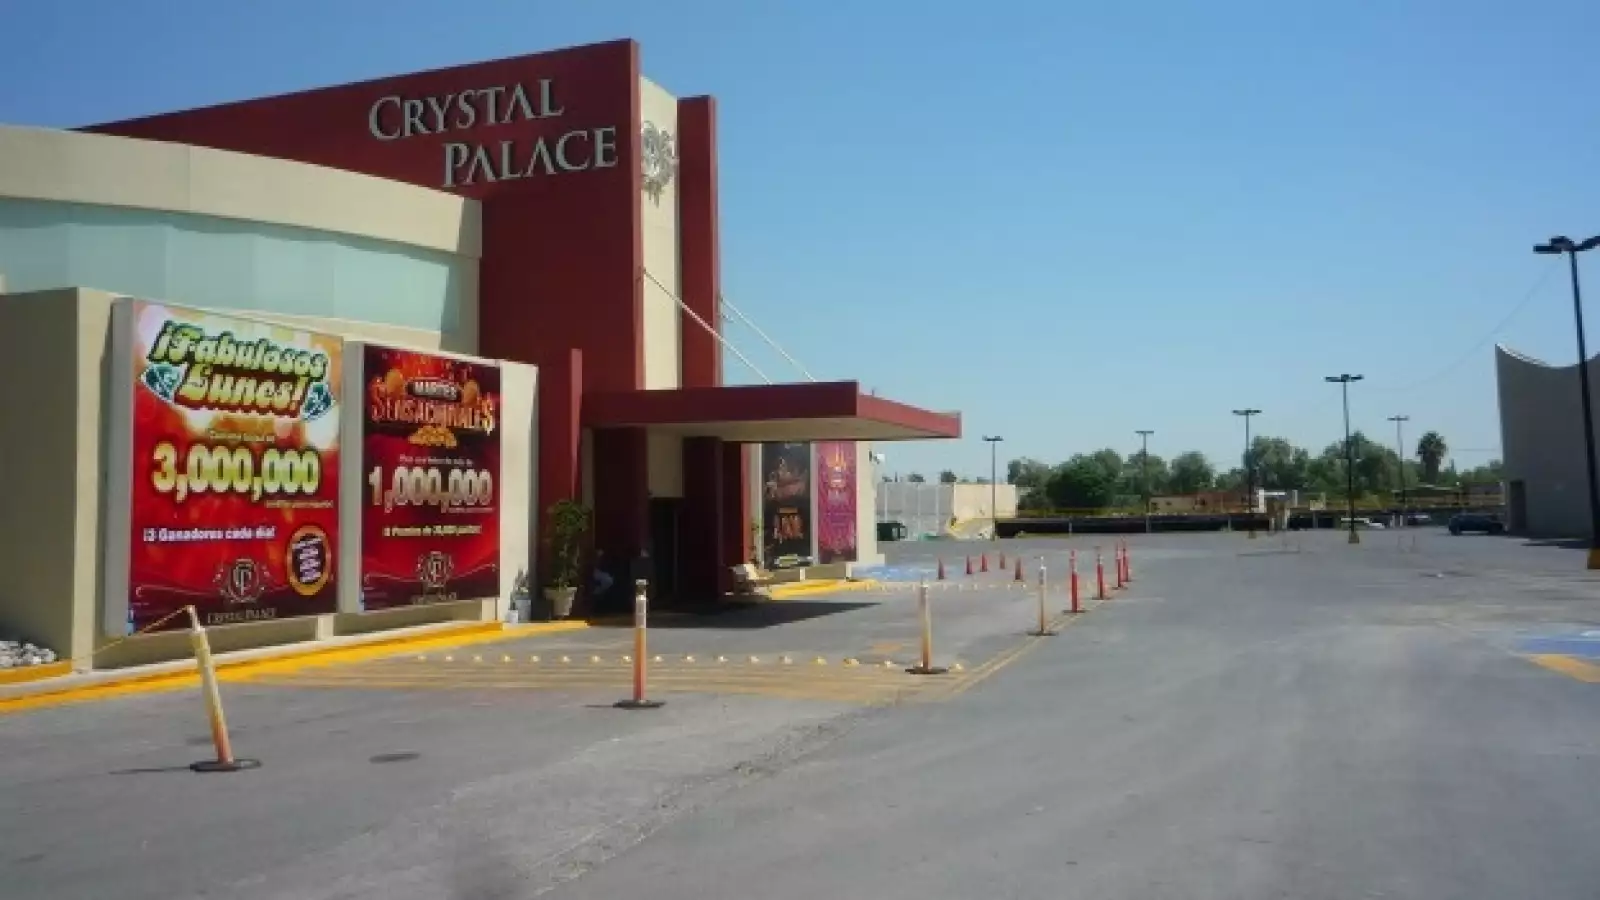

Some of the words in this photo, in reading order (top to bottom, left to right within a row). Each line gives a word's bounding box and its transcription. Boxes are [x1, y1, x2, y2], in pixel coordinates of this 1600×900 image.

[368, 78, 564, 141] CRYSTAL
[442, 126, 618, 188] PALACE
[178, 362, 310, 412] Lunes!
[152, 441, 320, 503] 3,000,000
[368, 466, 493, 513] 1,000,000
[159, 527, 223, 542] Ganadores
[225, 526, 252, 540] cada
